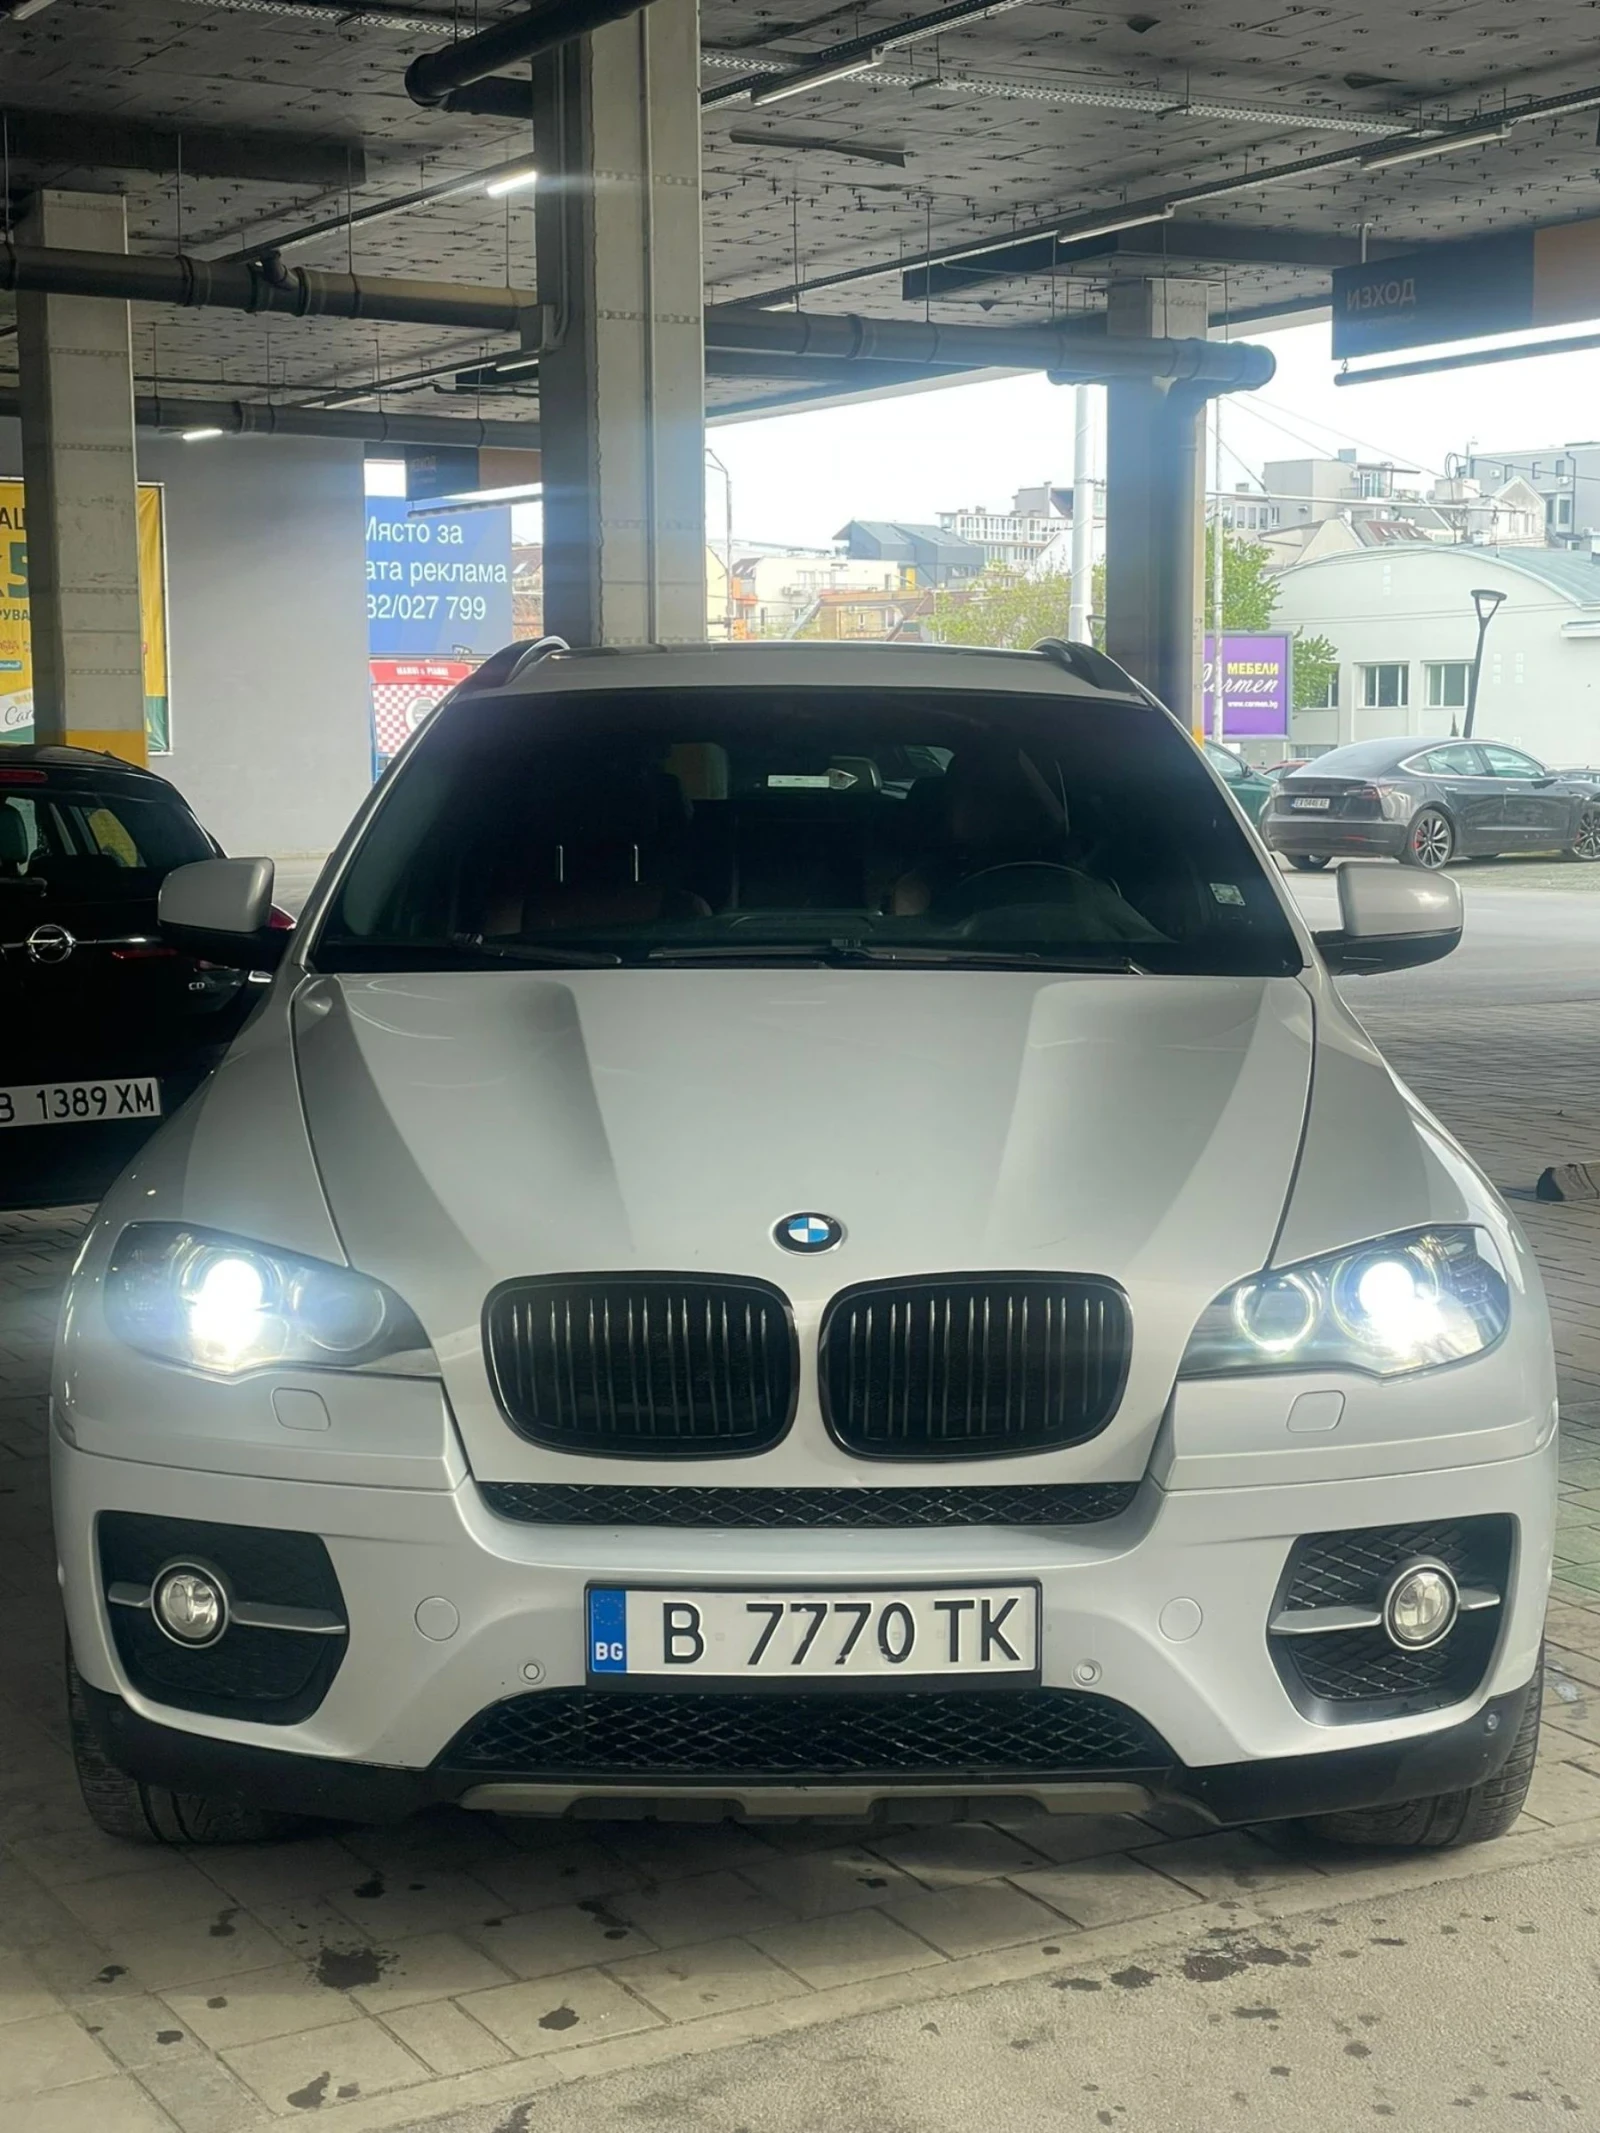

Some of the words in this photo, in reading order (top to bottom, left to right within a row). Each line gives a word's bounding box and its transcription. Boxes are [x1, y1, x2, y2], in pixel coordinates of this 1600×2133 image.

[1346, 278, 1417, 312] ИЗХОД
[437, 524, 464, 544] за
[410, 561, 507, 587] реклама
[446, 596, 486, 620] 799
[1227, 662, 1279, 675] МЕБЕЛИ
[5, 705, 34, 725] Car
[1227, 700, 1279, 709] www.carmen.bg
[36, 1086, 107, 1119] 1389
[115, 1083, 155, 1113] XM
[663, 1602, 705, 1664] B
[746, 1601, 916, 1665] 7770
[934, 1598, 1021, 1663] TK
[595, 1642, 623, 1661] BG
